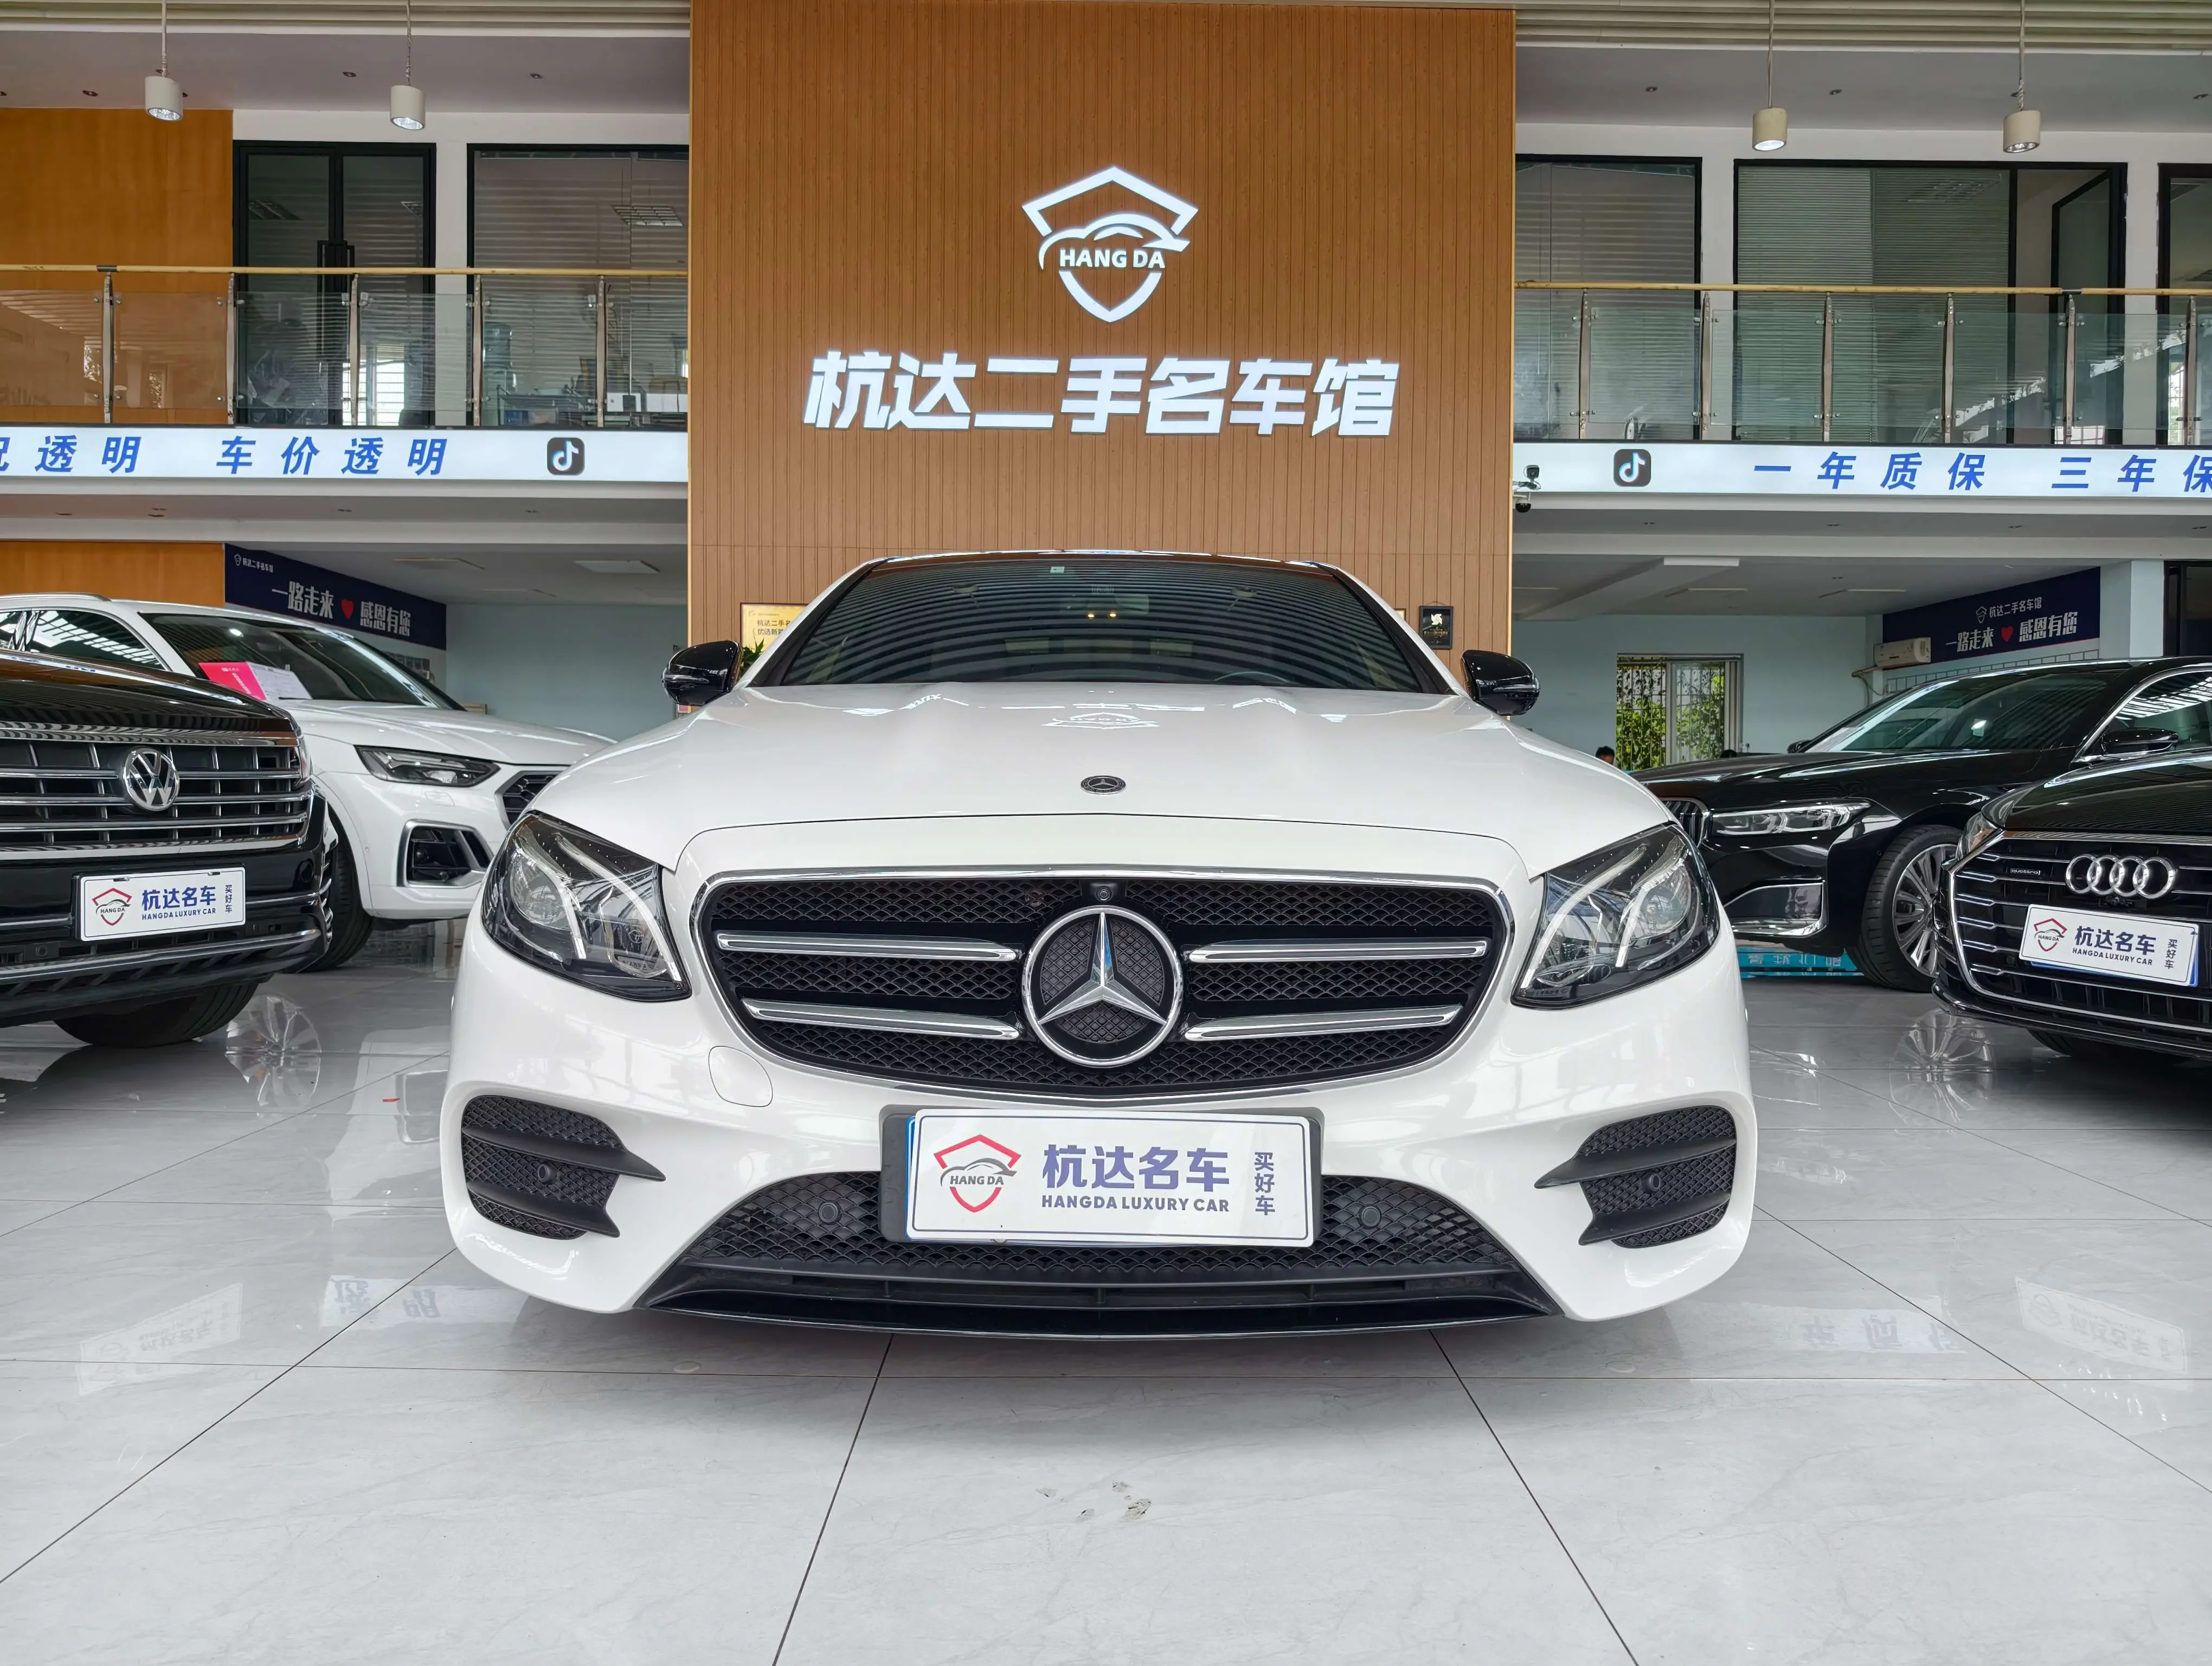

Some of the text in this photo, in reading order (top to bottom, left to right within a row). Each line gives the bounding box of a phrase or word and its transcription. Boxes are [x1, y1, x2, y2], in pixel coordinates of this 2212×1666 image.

[1059, 248, 1166, 270] HANG DA
[804, 350, 1399, 437] 杭达二手名车馆
[0, 435, 447, 476] 透明 车价透明
[1754, 451, 2212, 493] 一年质保 三年保
[272, 581, 411, 637] 一路走来 感恩有您
[1989, 597, 2042, 618] 杭达二手名车馆
[1946, 612, 2078, 652] 一路走来 感恩有您
[142, 886, 216, 911] 杭达名车
[142, 911, 173, 920] HANGDA
[175, 909, 201, 918] LUXURY
[2074, 925, 2157, 956] 杭达名车
[2164, 939, 2177, 969] 买好车
[2072, 947, 2152, 965] HANGDA LUXURY CAR
[950, 1175, 1004, 1186] HANG DA
[1042, 1144, 1229, 1192] 杭达名车
[1254, 1151, 1275, 1216] 买好车
[1041, 1195, 1230, 1213] HANGDA LUXURY CAR
